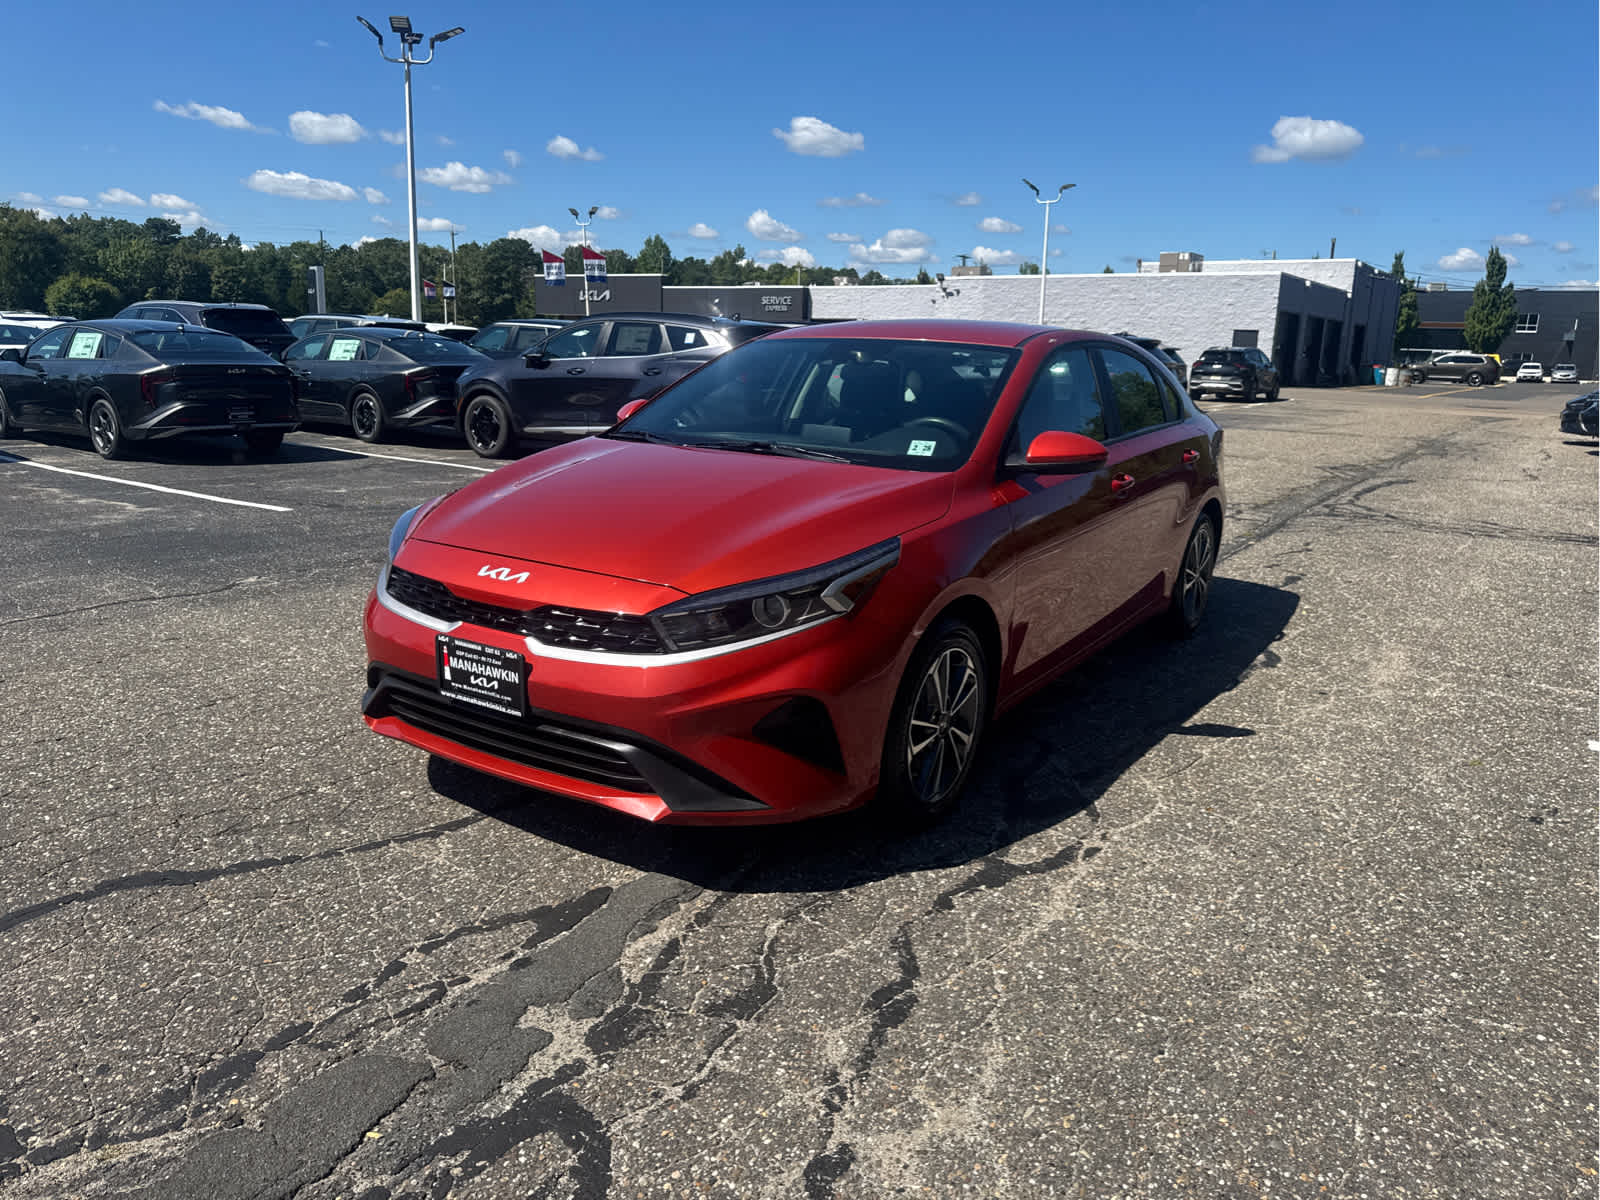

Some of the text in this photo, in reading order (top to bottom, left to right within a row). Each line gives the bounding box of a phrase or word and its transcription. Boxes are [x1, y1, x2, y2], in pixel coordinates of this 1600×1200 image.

[579, 290, 610, 300] KIA
[762, 296, 792, 304] SERVICE
[478, 564, 530, 584] KIA
[450, 656, 519, 684] MANAHAWKIN
[470, 675, 498, 690] KIA
